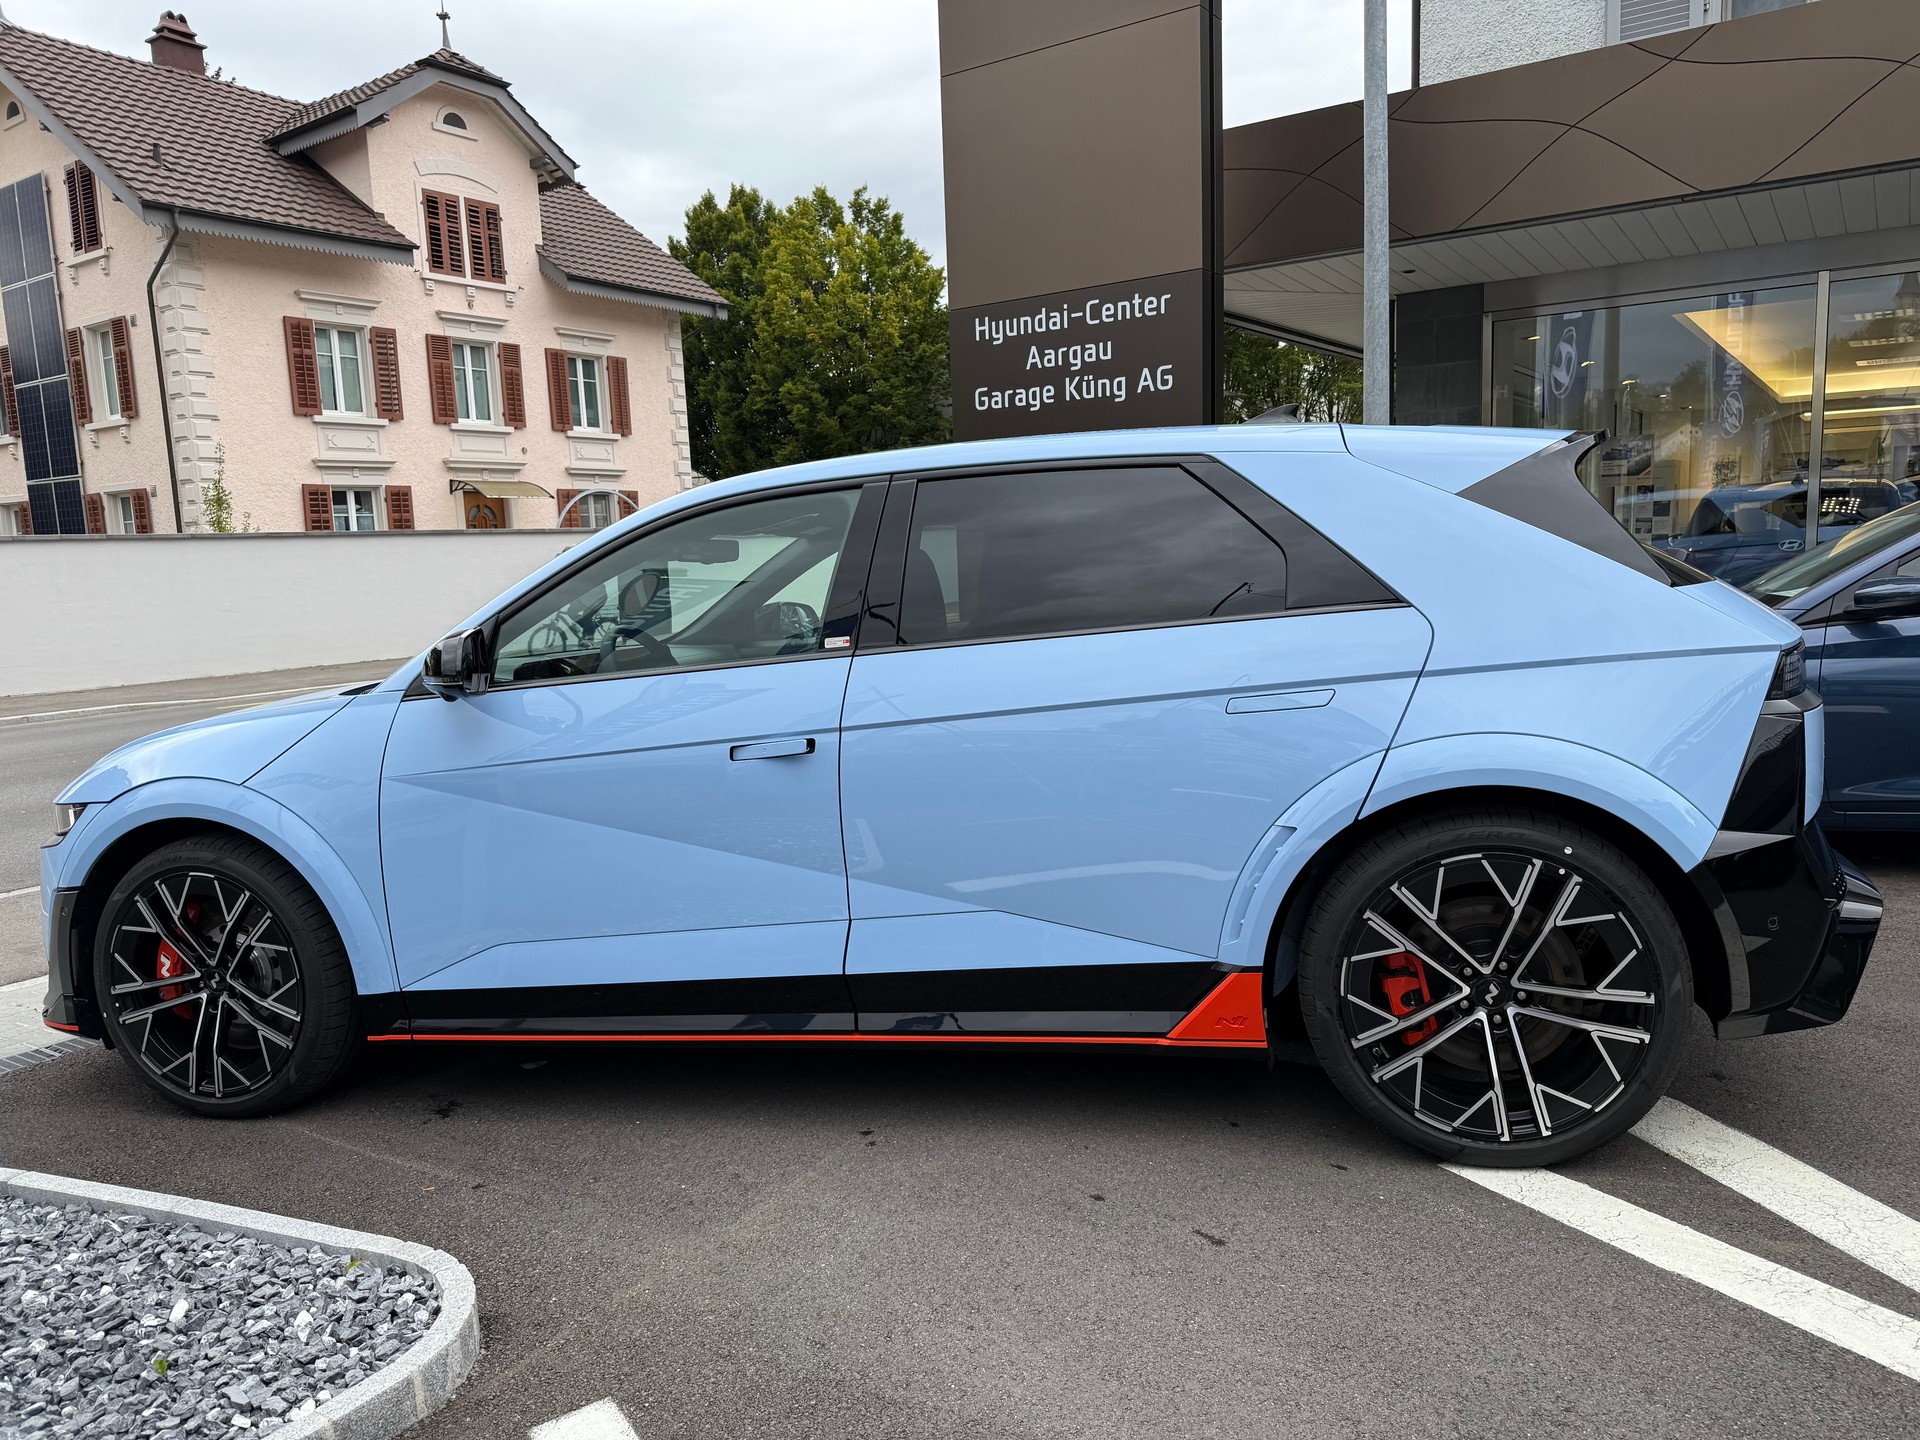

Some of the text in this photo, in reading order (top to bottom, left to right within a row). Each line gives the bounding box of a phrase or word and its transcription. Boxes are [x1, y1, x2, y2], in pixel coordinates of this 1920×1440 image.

[975, 293, 1171, 345] Hyundai-Center
[1026, 340, 1112, 371] Aargau
[974, 364, 1173, 412] Garage Küng AG
